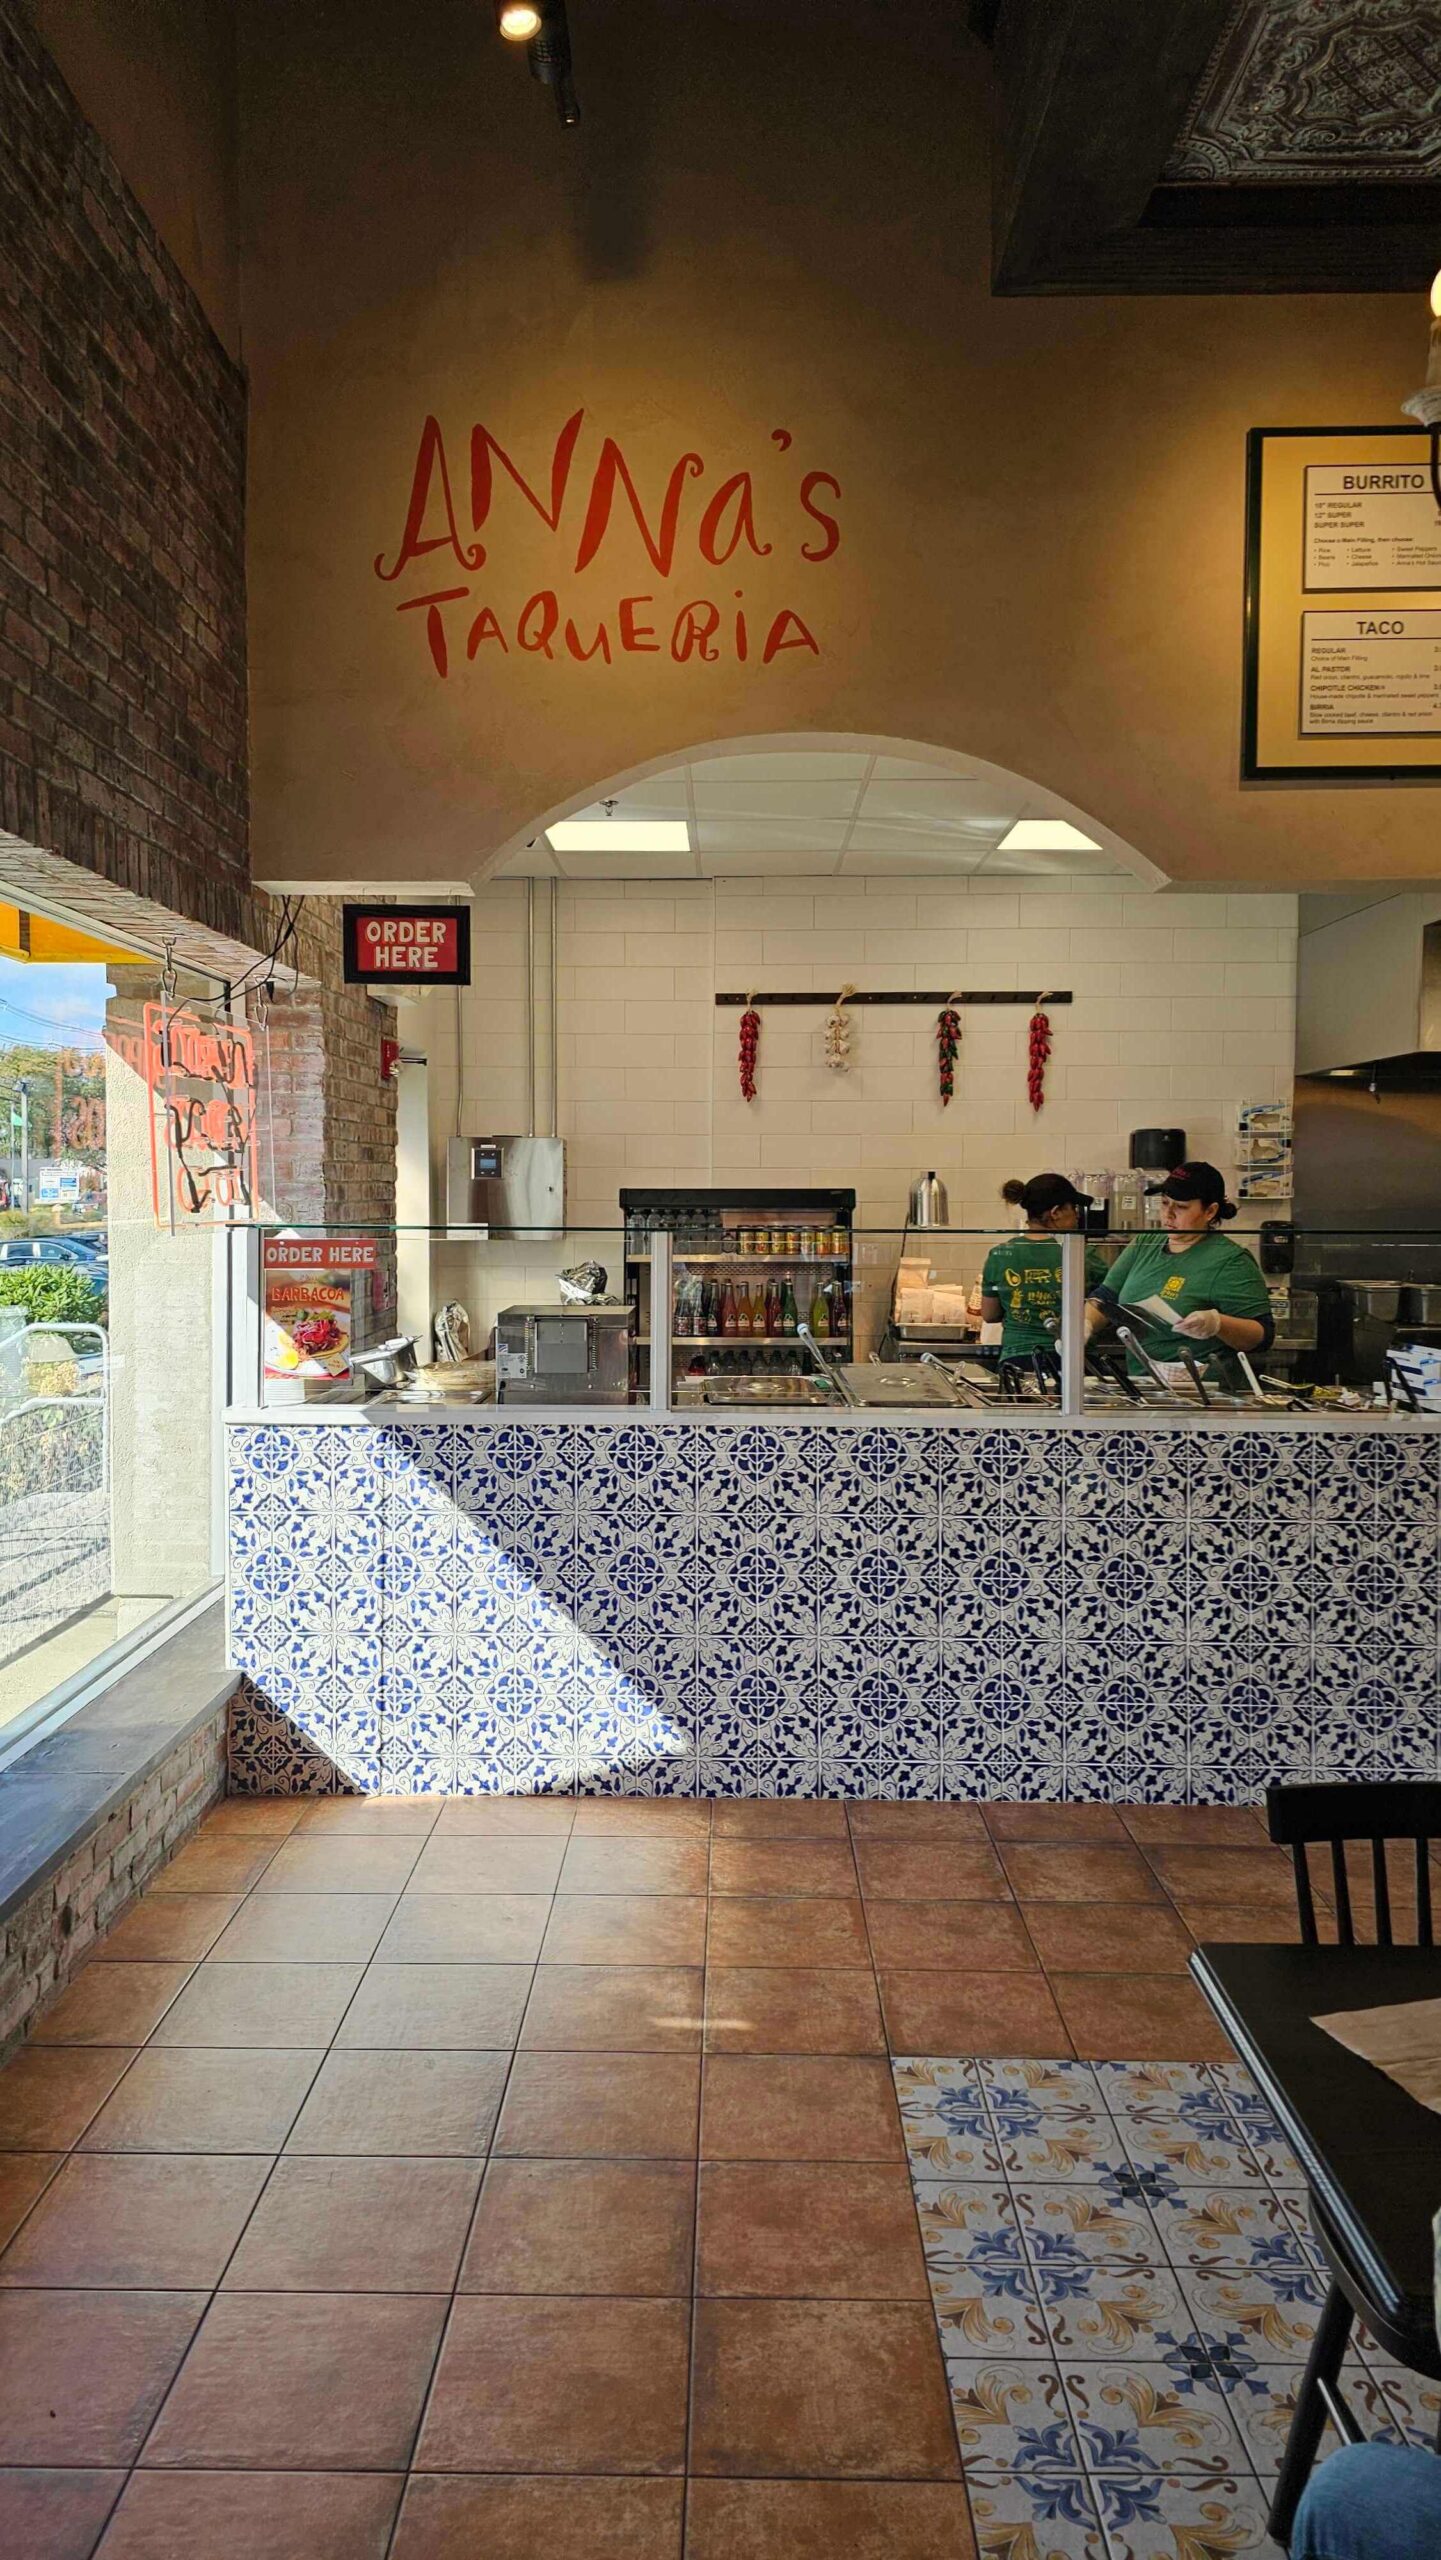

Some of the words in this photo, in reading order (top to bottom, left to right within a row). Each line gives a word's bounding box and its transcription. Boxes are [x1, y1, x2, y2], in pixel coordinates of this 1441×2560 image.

[1343, 475, 1424, 489] BURRITO
[1357, 621, 1404, 635] TACO
[366, 921, 447, 944] ORDER
[374, 946, 438, 968] HERE
[266, 1246, 323, 1262] ORDER
[329, 1246, 374, 1262] HERE
[272, 1287, 345, 1301] BARBACOA
